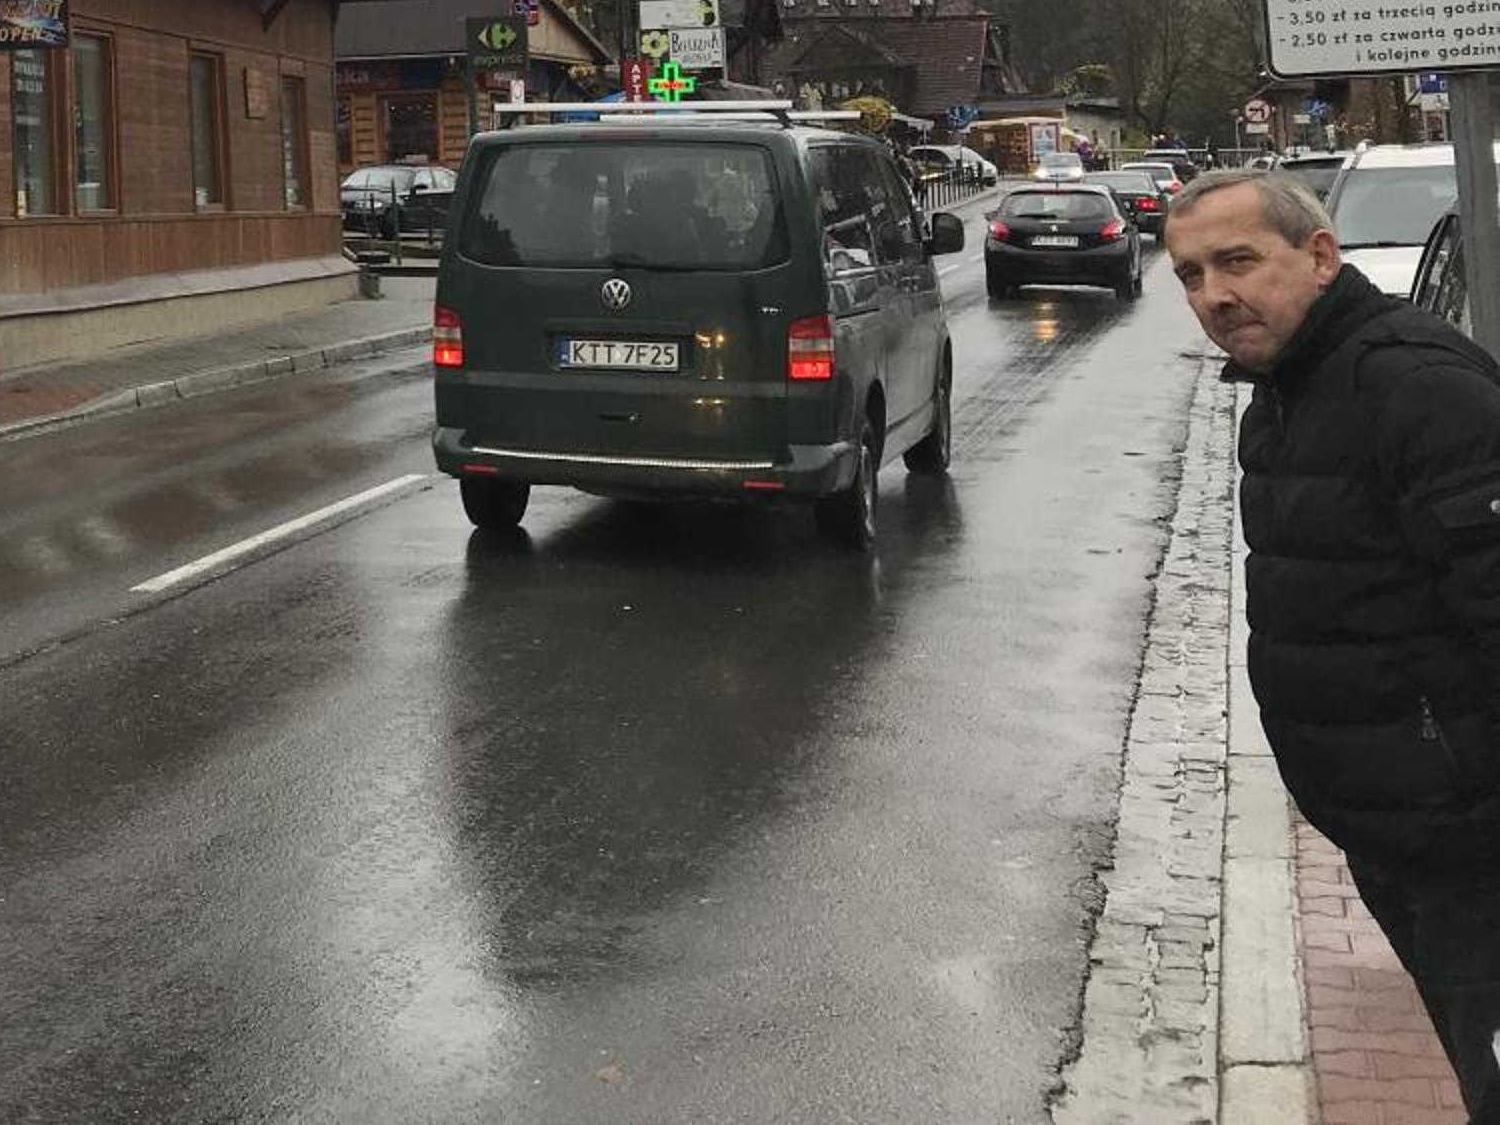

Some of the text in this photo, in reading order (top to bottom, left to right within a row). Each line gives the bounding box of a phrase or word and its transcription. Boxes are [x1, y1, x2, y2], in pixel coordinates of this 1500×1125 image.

[1353, 11, 1371, 20] za
[1355, 33, 1373, 44] za
[1367, 46, 1430, 63] kolejne
[573, 342, 676, 366] KTT 7F25
